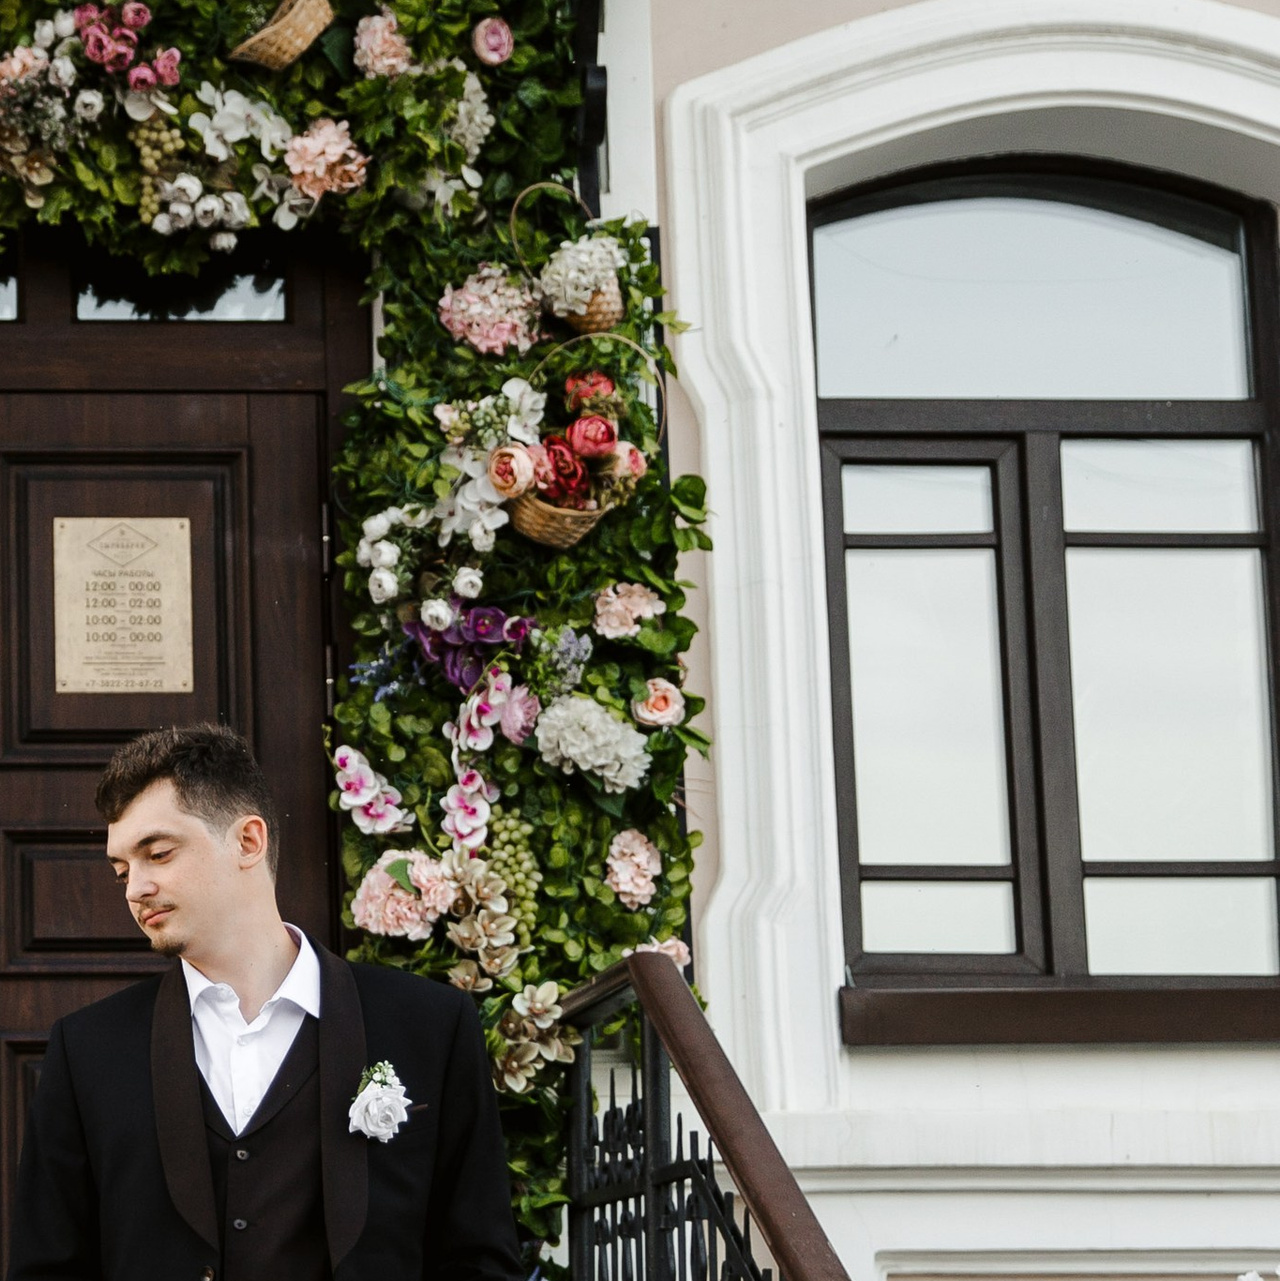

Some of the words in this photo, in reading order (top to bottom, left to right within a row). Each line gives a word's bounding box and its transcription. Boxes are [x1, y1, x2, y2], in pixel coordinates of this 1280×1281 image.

[92, 570, 116, 578] ЧАСЫ
[85, 581, 117, 592] 12:00
[128, 581, 162, 592] 00:00
[85, 598, 117, 608] 12:00
[128, 598, 162, 608] 02:00
[85, 615, 117, 626] 10:00
[128, 615, 162, 626] 02:00
[85, 632, 117, 642] 10:00
[128, 632, 162, 642] 00:00
